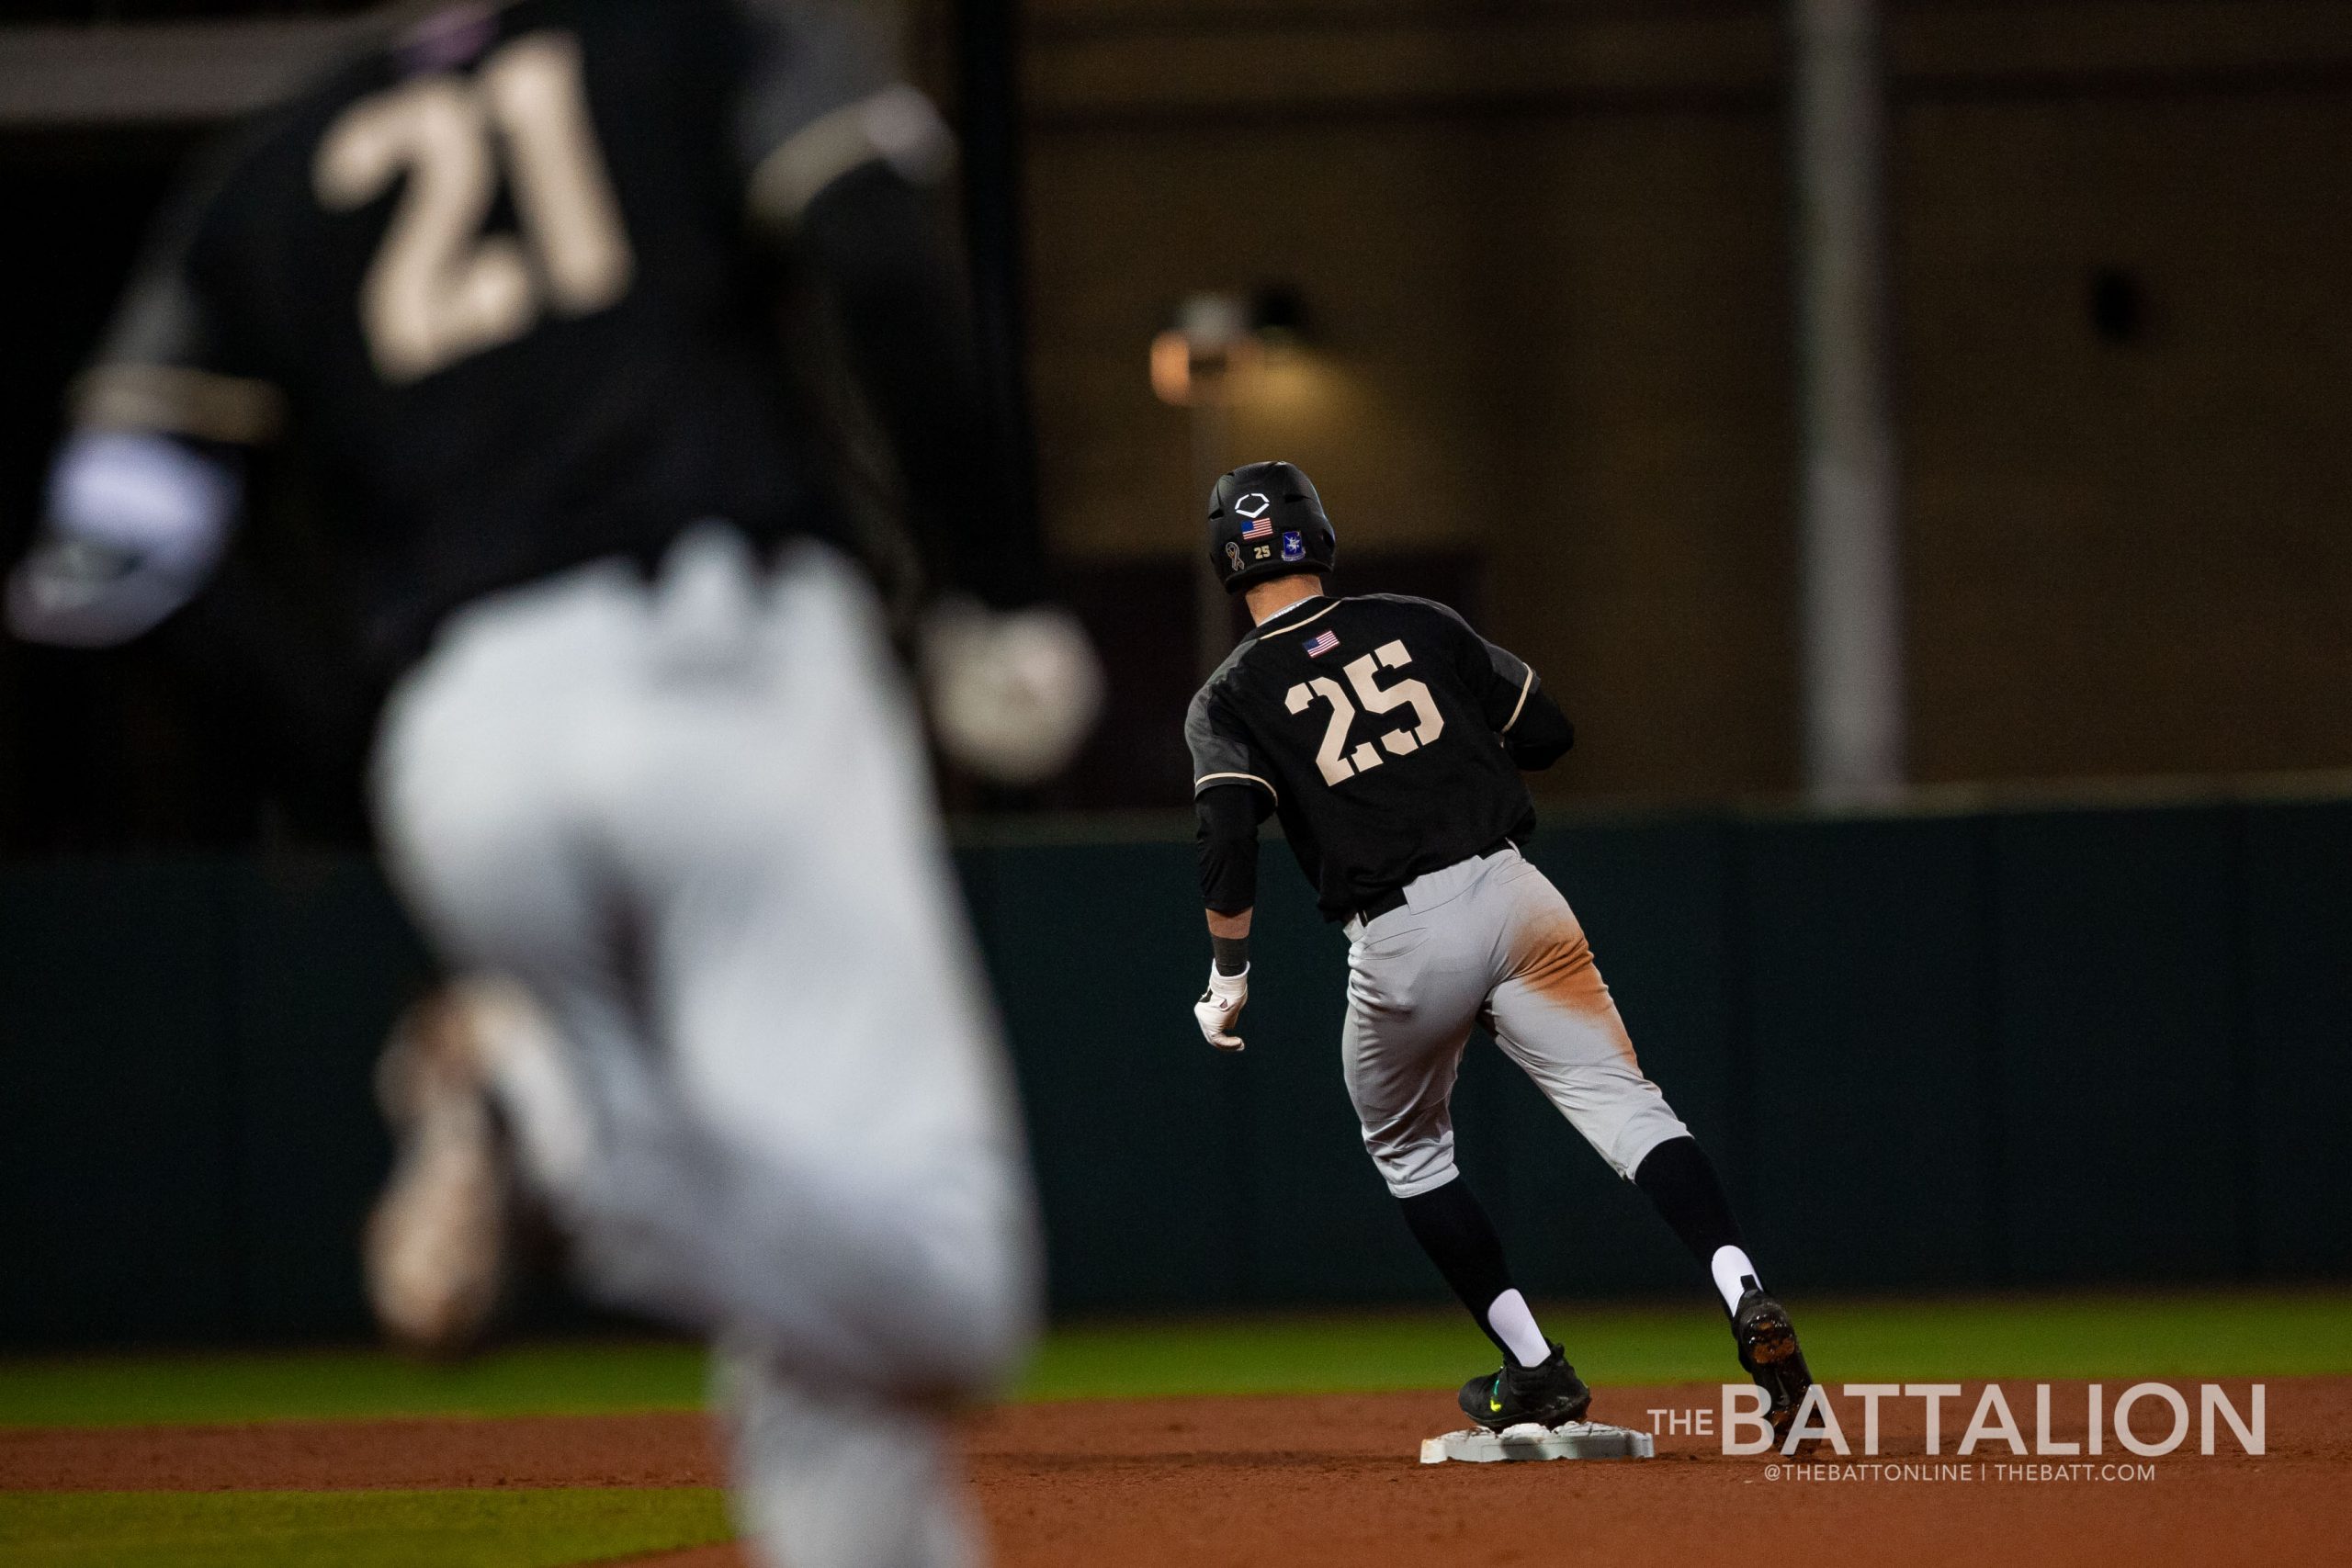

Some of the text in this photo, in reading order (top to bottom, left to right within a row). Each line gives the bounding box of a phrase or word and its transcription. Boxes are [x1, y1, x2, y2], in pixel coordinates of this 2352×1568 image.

[315, 33, 632, 383] 21
[1254, 545, 1271, 559] 25
[1284, 639, 1444, 787] 25
